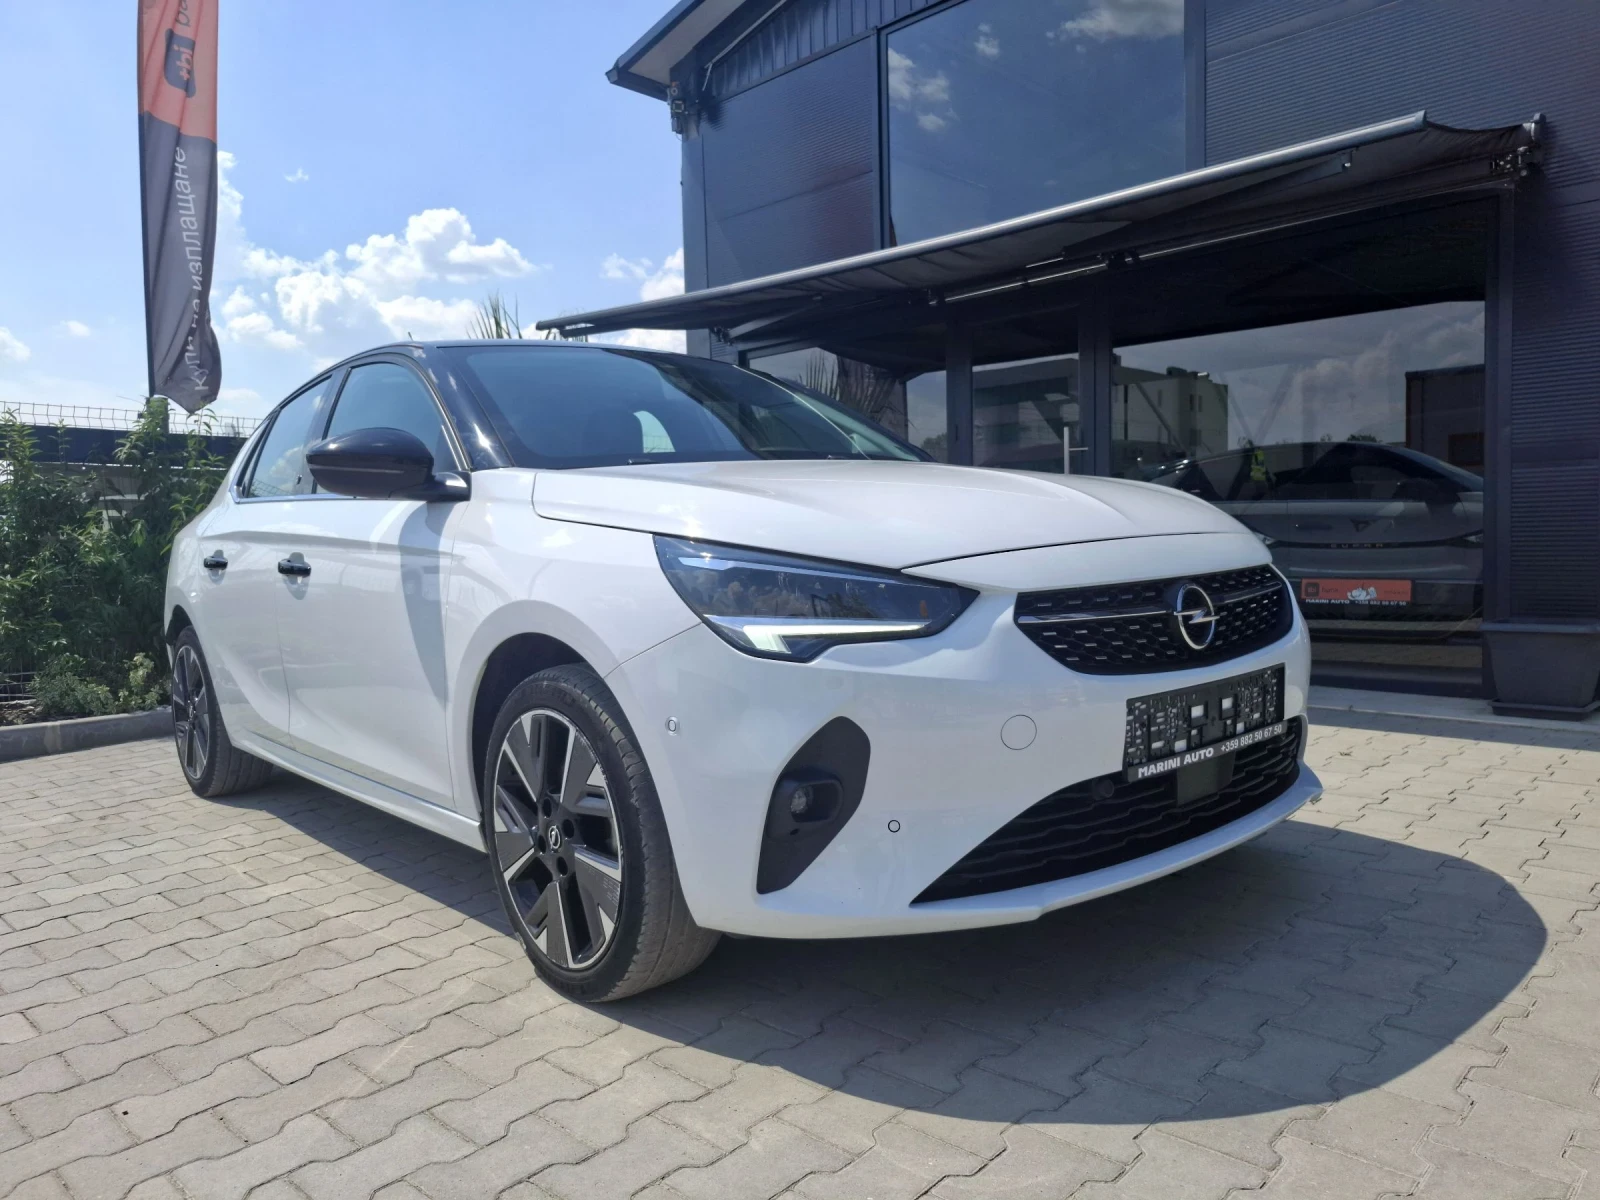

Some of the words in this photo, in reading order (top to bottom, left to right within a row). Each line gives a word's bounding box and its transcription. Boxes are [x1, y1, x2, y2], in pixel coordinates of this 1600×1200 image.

[174, 146, 203, 291] изплащане
[1137, 756, 1181, 779] MARINI
[1183, 747, 1214, 765] AUTO
[1220, 738, 1239, 753] +359
[1240, 736, 1254, 748] 882
[1255, 730, 1263, 741] 50
[1264, 727, 1273, 738] 67
[1274, 724, 1282, 735] 50
